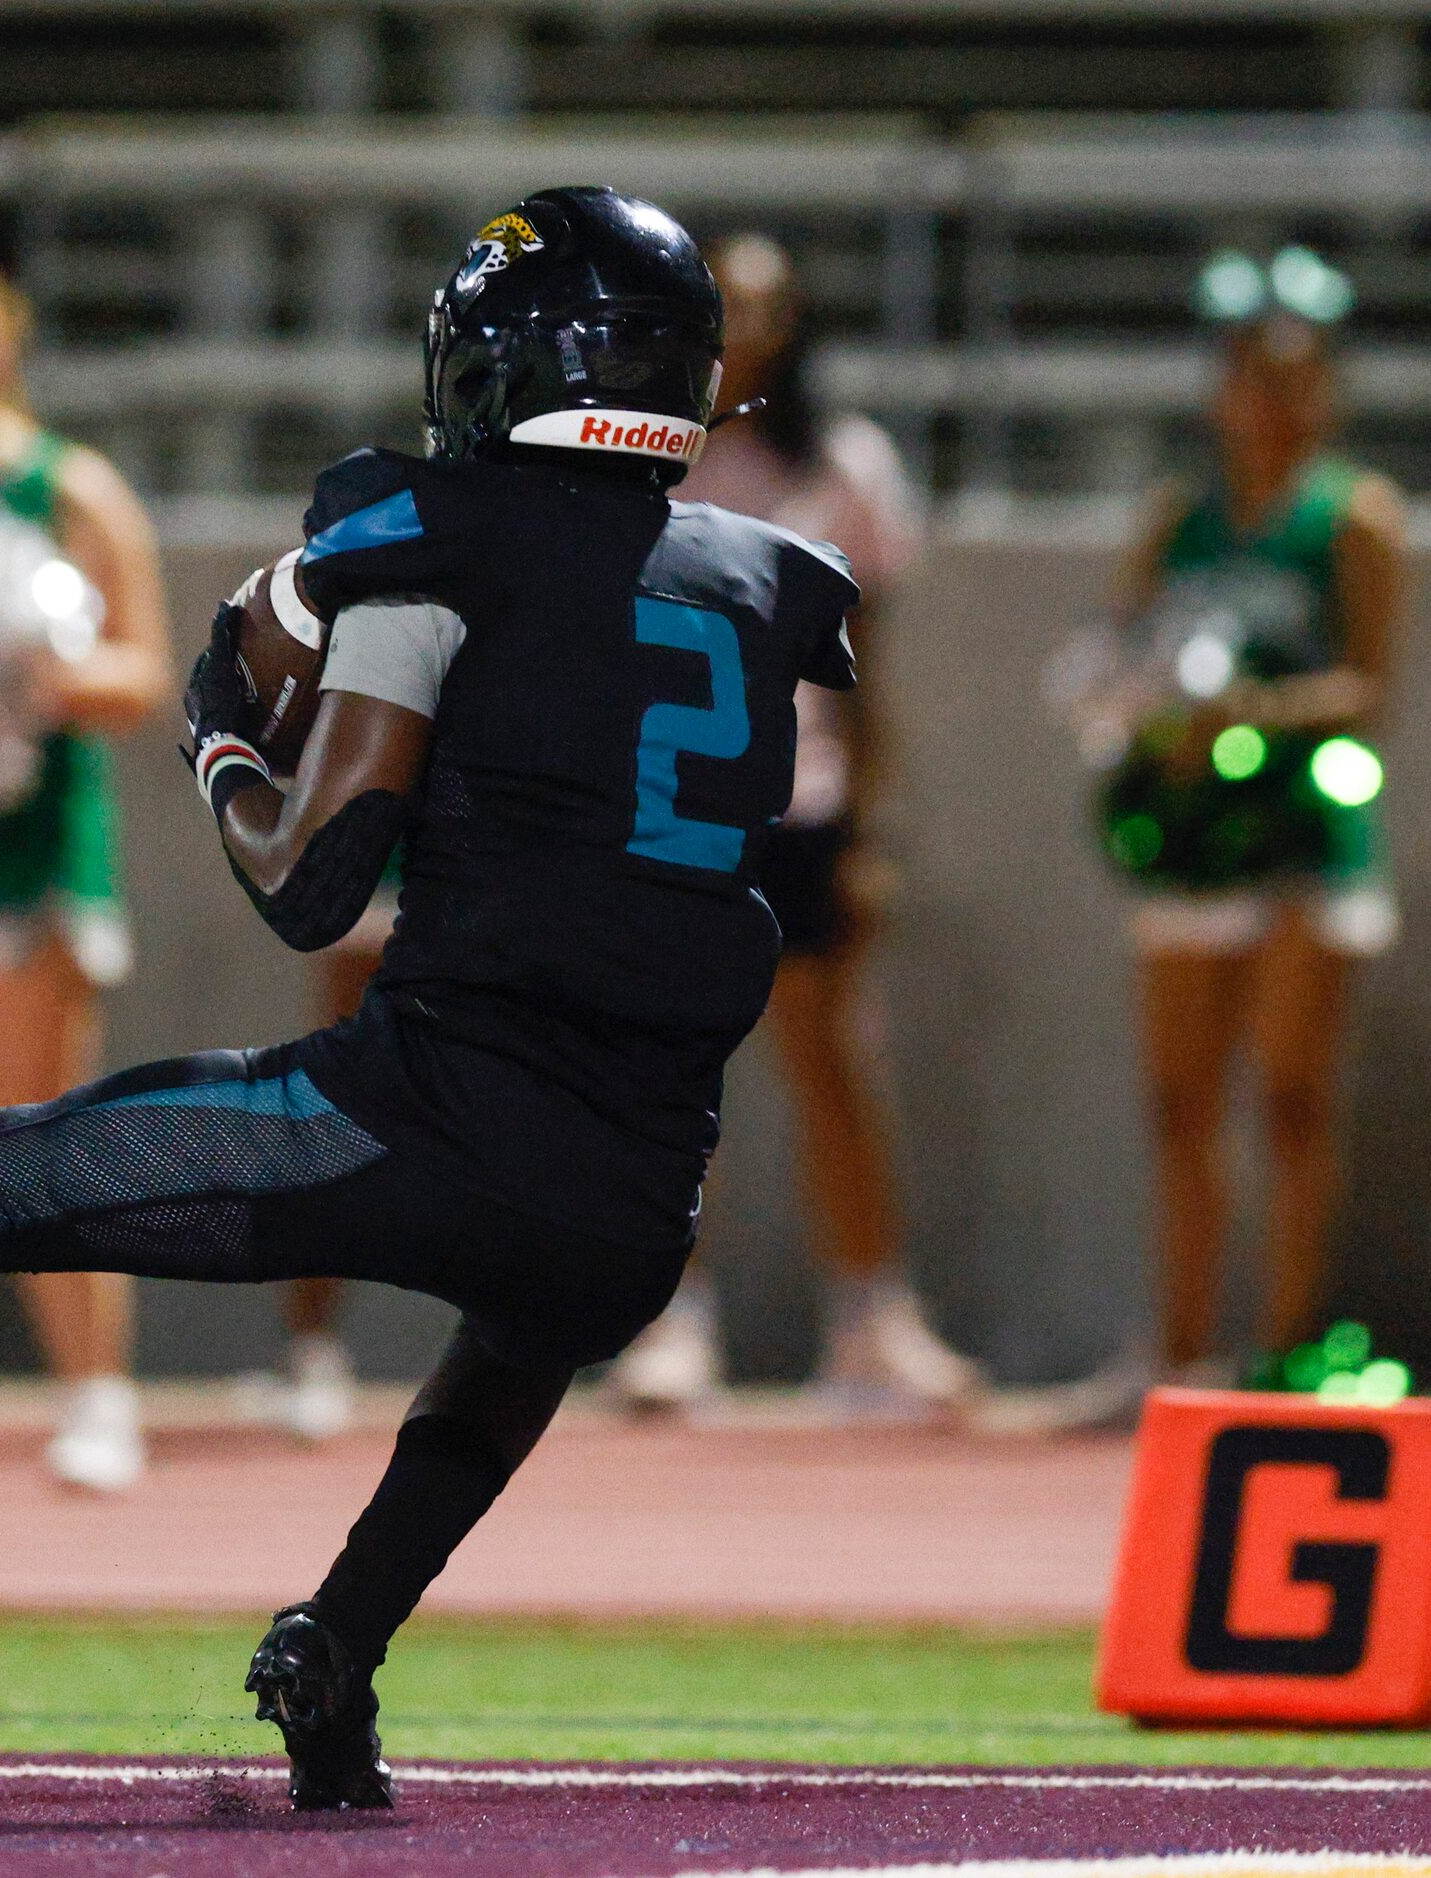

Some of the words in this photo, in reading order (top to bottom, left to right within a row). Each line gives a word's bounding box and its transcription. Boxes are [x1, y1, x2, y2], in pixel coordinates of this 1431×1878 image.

[580, 416, 699, 456] Riddell
[626, 596, 751, 873] 2
[1185, 1425, 1392, 1677] G
